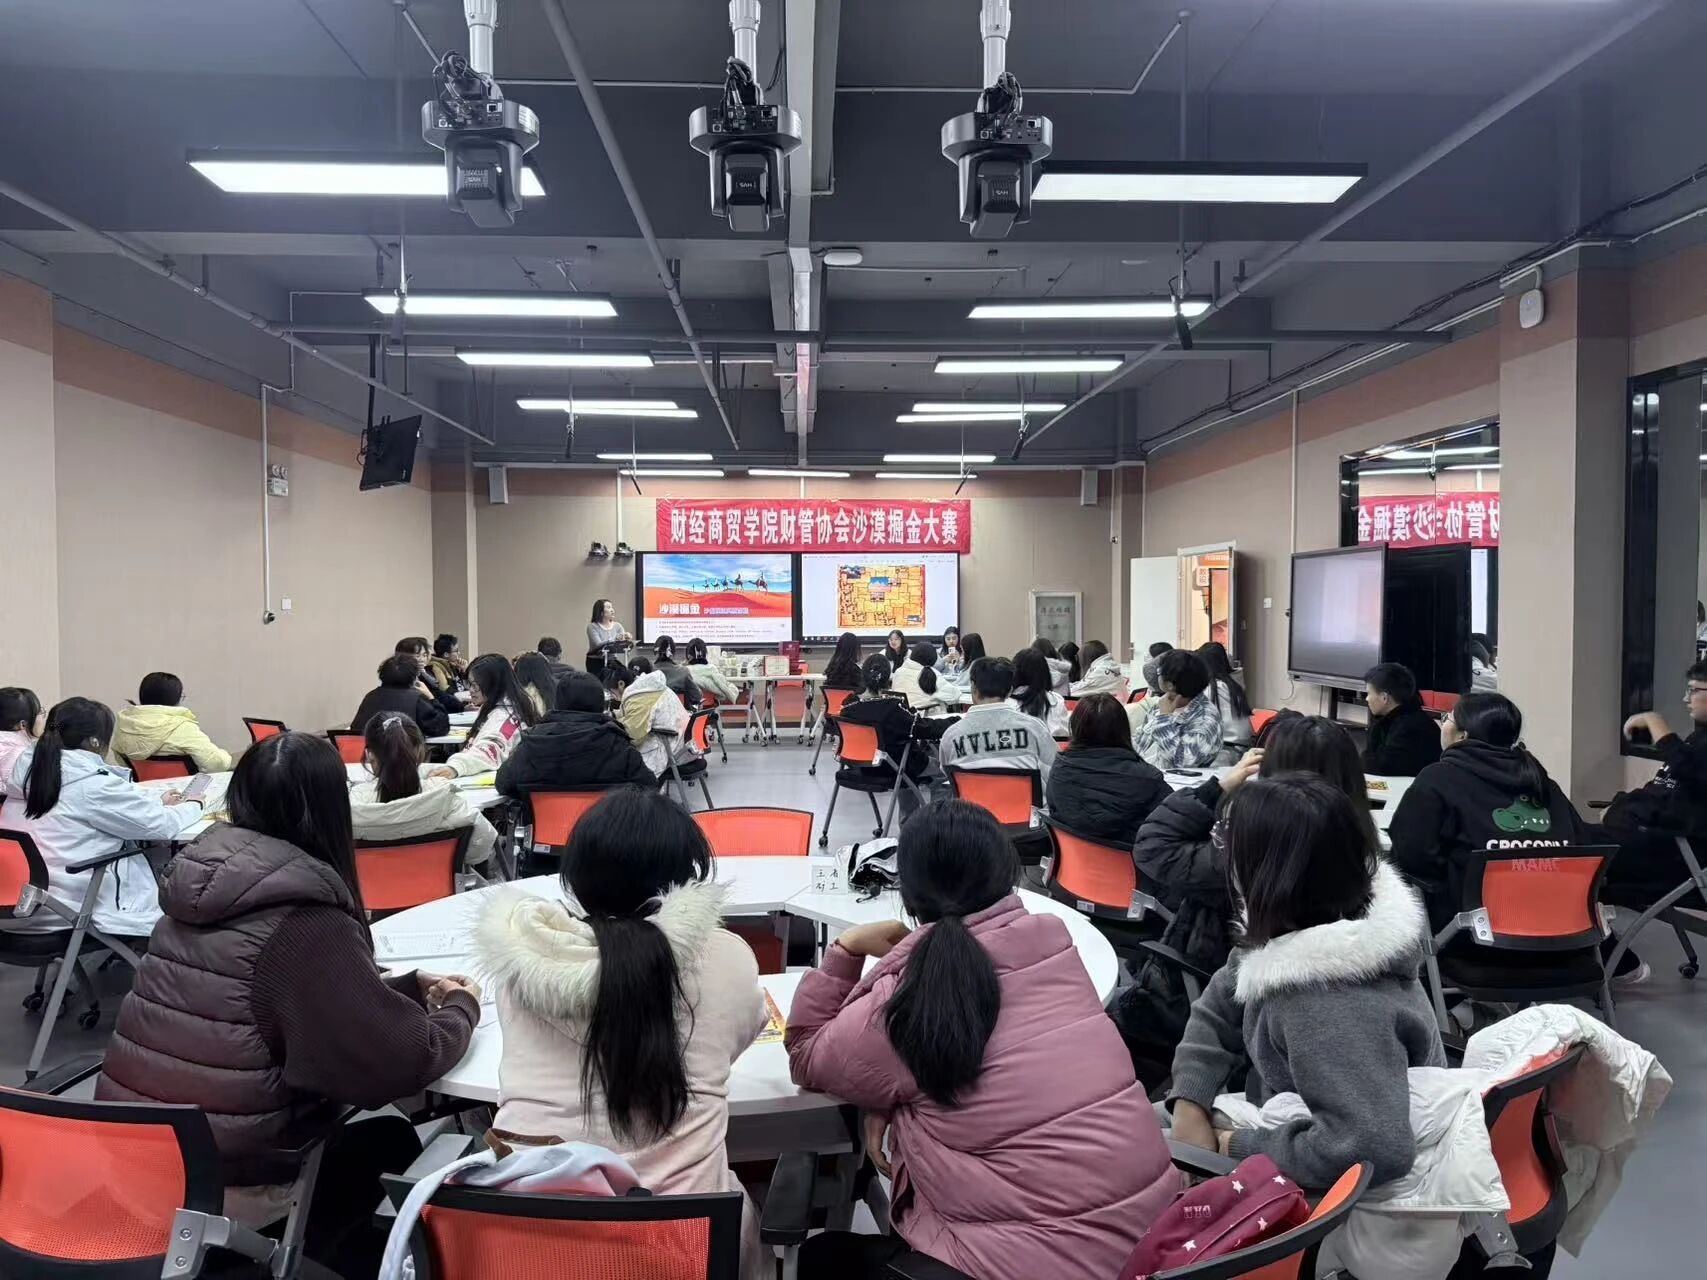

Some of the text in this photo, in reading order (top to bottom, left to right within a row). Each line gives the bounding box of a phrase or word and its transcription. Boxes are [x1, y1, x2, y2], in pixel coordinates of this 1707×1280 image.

[670, 507, 958, 545] 财经商贸学院财管协会沙漠掘金大赛
